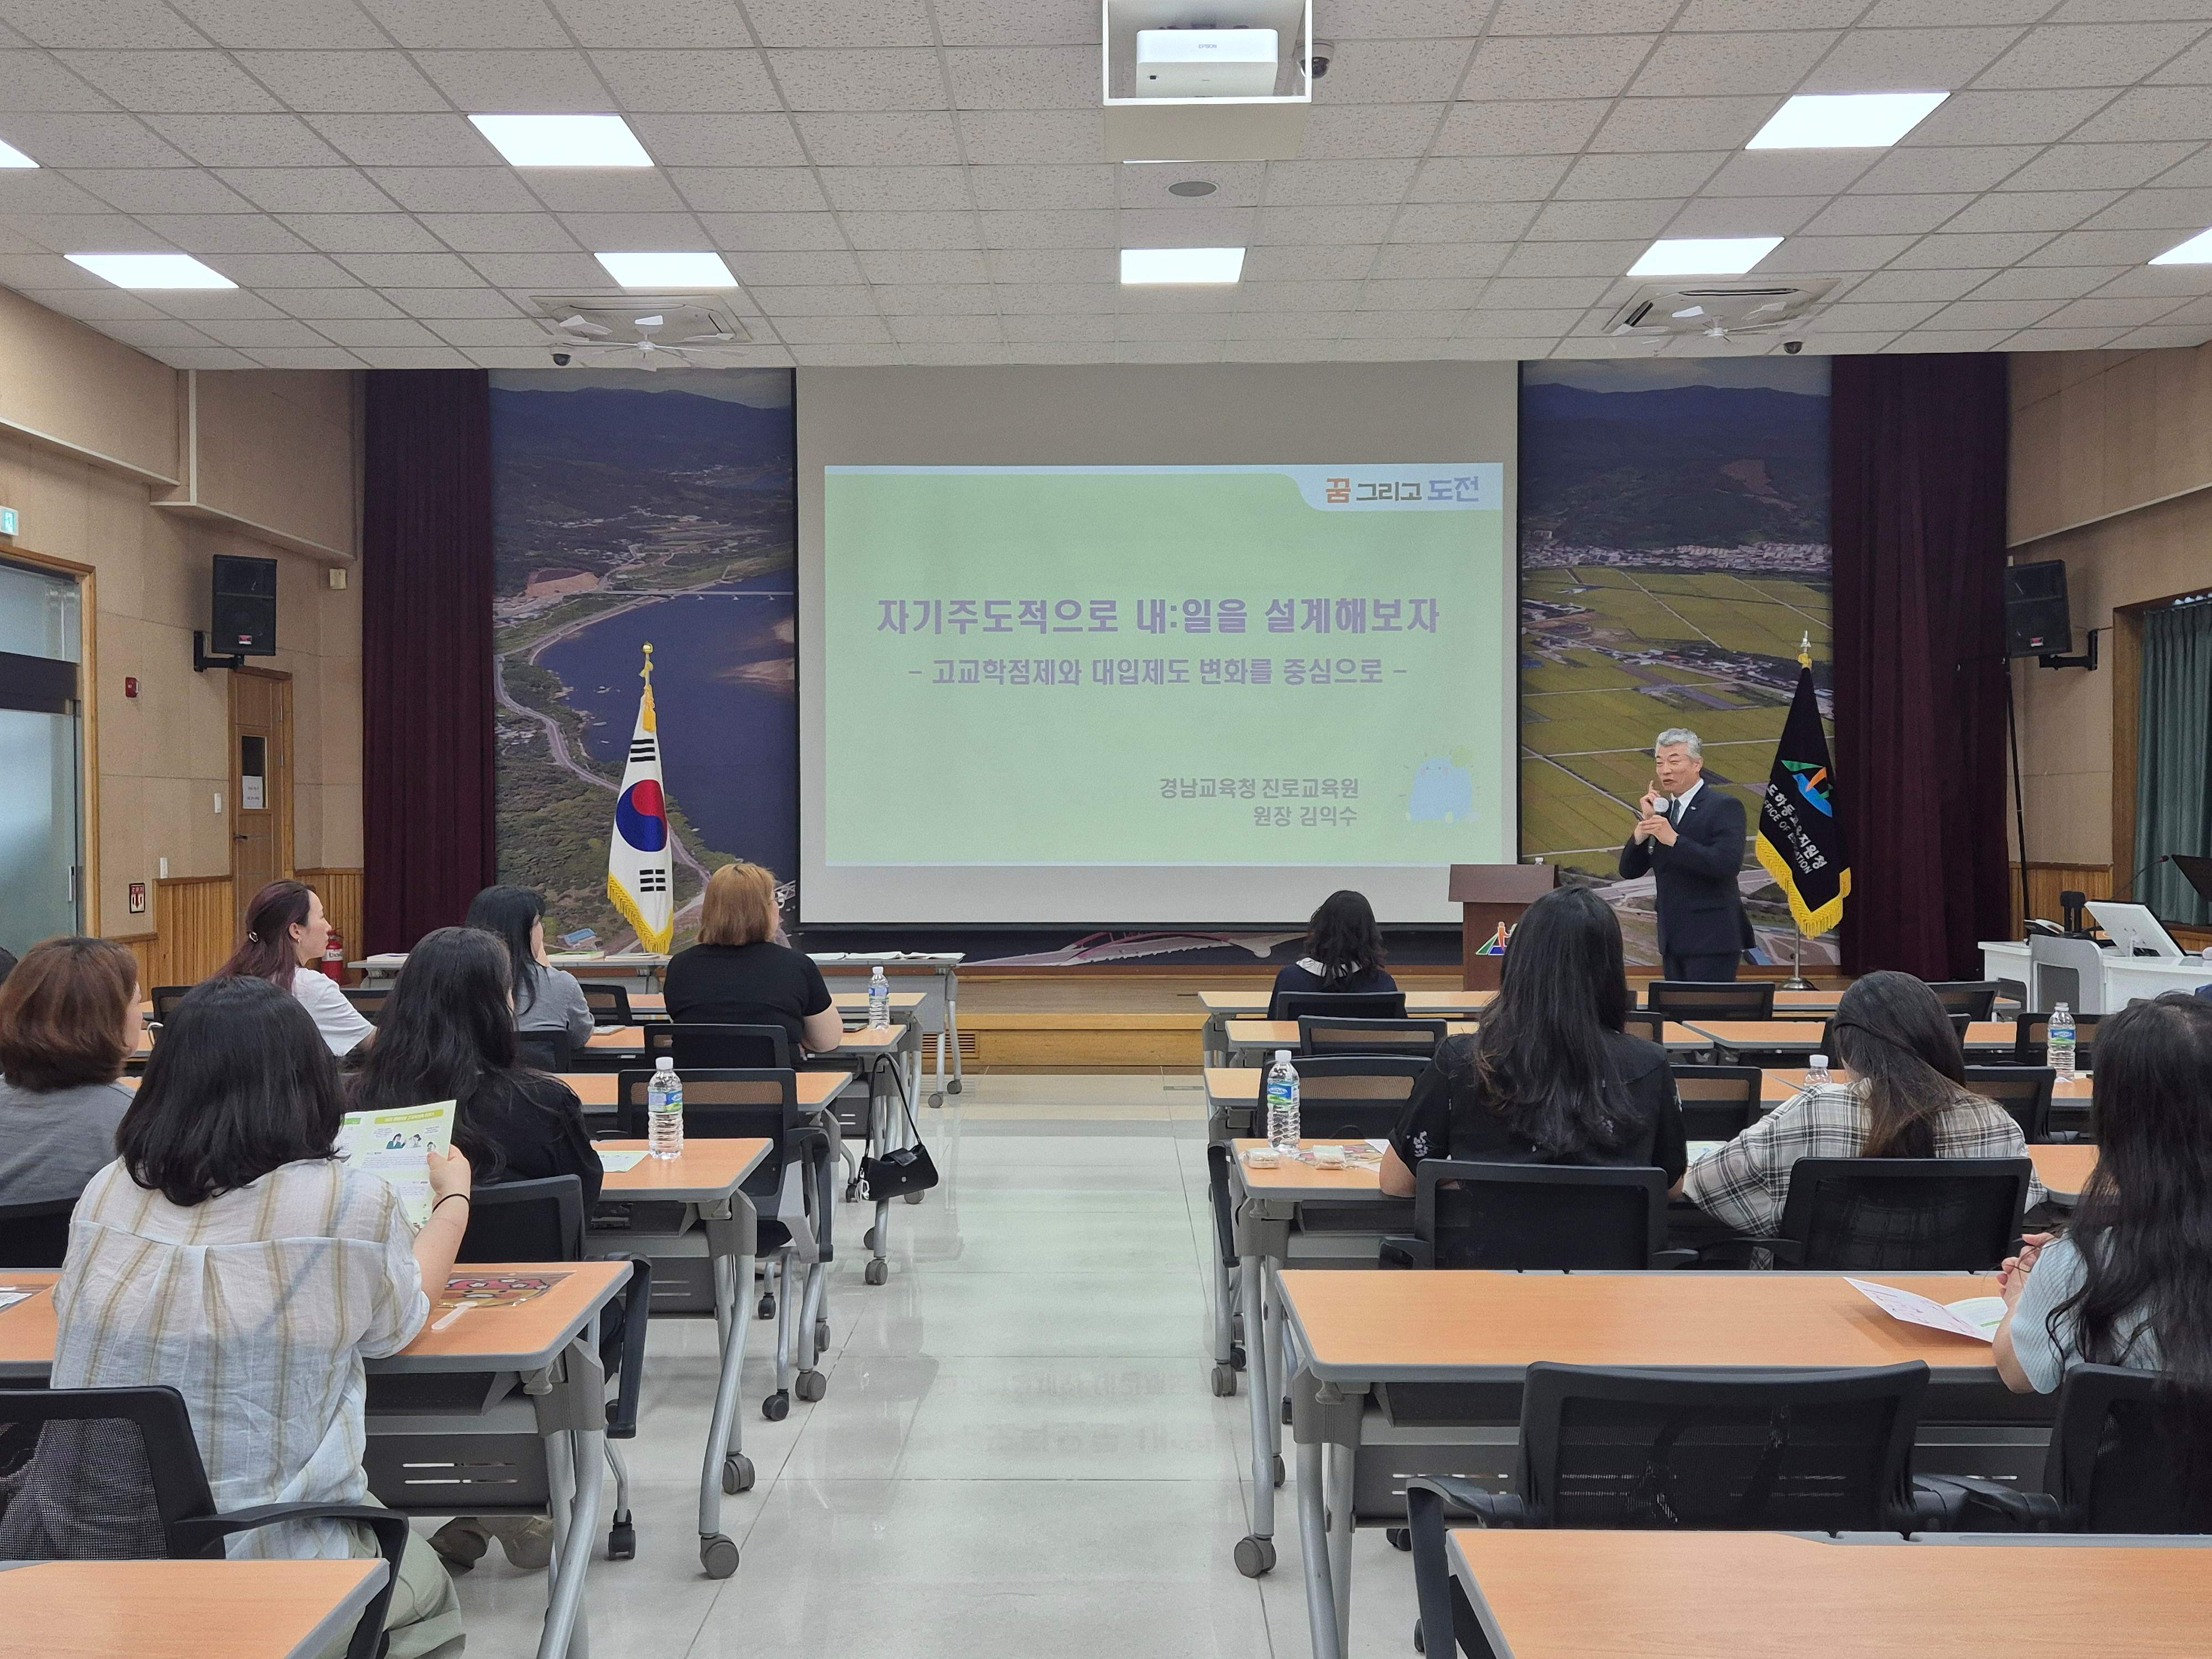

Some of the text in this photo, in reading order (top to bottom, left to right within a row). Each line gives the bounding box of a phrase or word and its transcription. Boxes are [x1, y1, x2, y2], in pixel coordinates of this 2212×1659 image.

[1325, 476, 1479, 504] 꿈 그리고 도전
[877, 597, 1440, 635] 자기주도적으로 내:일을 설계해보자
[932, 659, 1082, 686] 고교학점제와
[1092, 659, 1190, 685] 대입제도
[1199, 658, 1272, 685] 변화를
[1283, 658, 1383, 686] 중심으로
[1160, 778, 1359, 800] 경남교육청 진로교육원
[1253, 806, 1358, 827] 원장 김익수
[1779, 821, 1791, 832] OF
